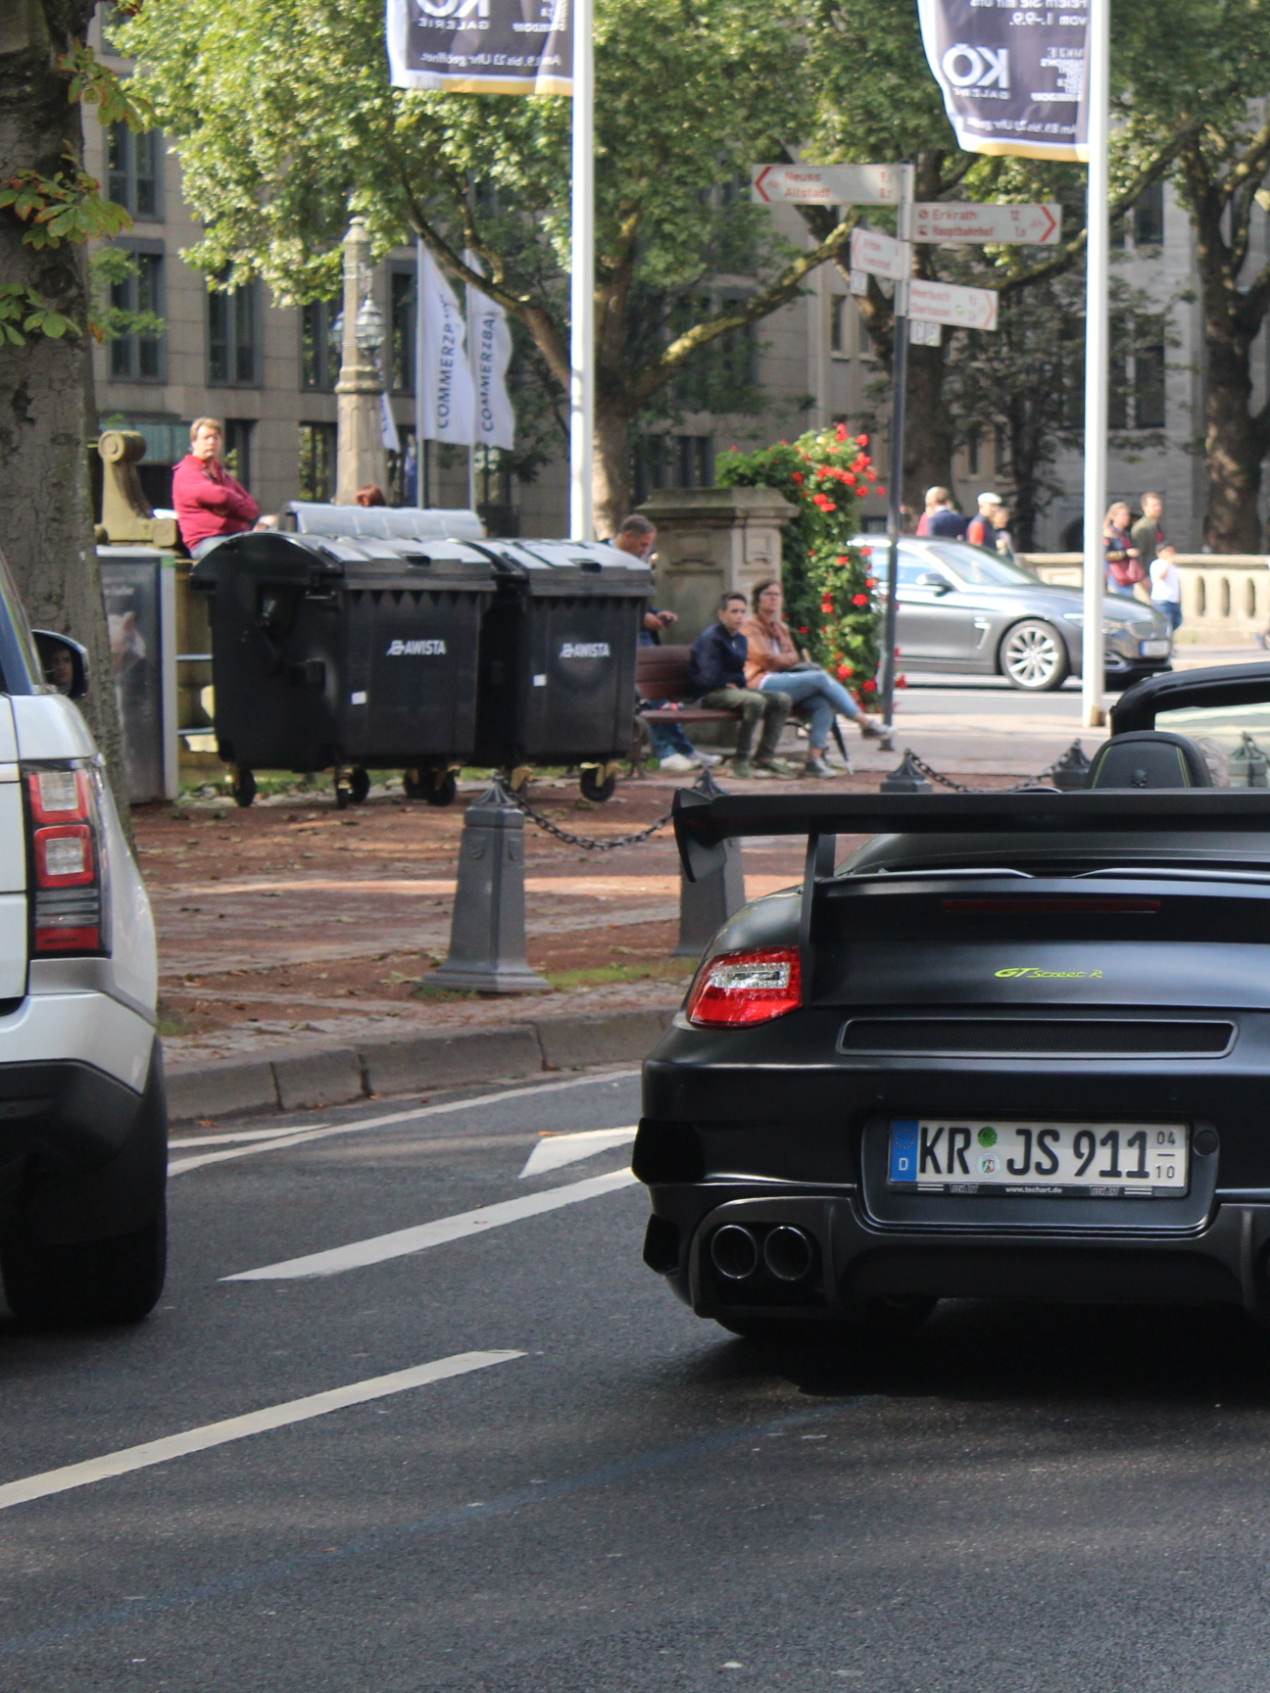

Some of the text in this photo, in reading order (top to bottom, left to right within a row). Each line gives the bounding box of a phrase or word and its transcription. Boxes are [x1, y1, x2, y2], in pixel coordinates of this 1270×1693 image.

[784, 171, 822, 183] Neuss
[783, 186, 831, 199] Altstadt
[932, 209, 978, 221] Erkrath
[404, 639, 447, 656] AWISTA
[573, 643, 611, 658] AWISTA
[994, 967, 1103, 979] GT Street R
[1157, 1130, 1177, 1146] 04
[919, 1127, 1151, 1179] KR JS 911
[899, 1157, 909, 1172] D
[1155, 1164, 1176, 1179] 10
[1005, 1186, 1063, 1195] www.techart.de
